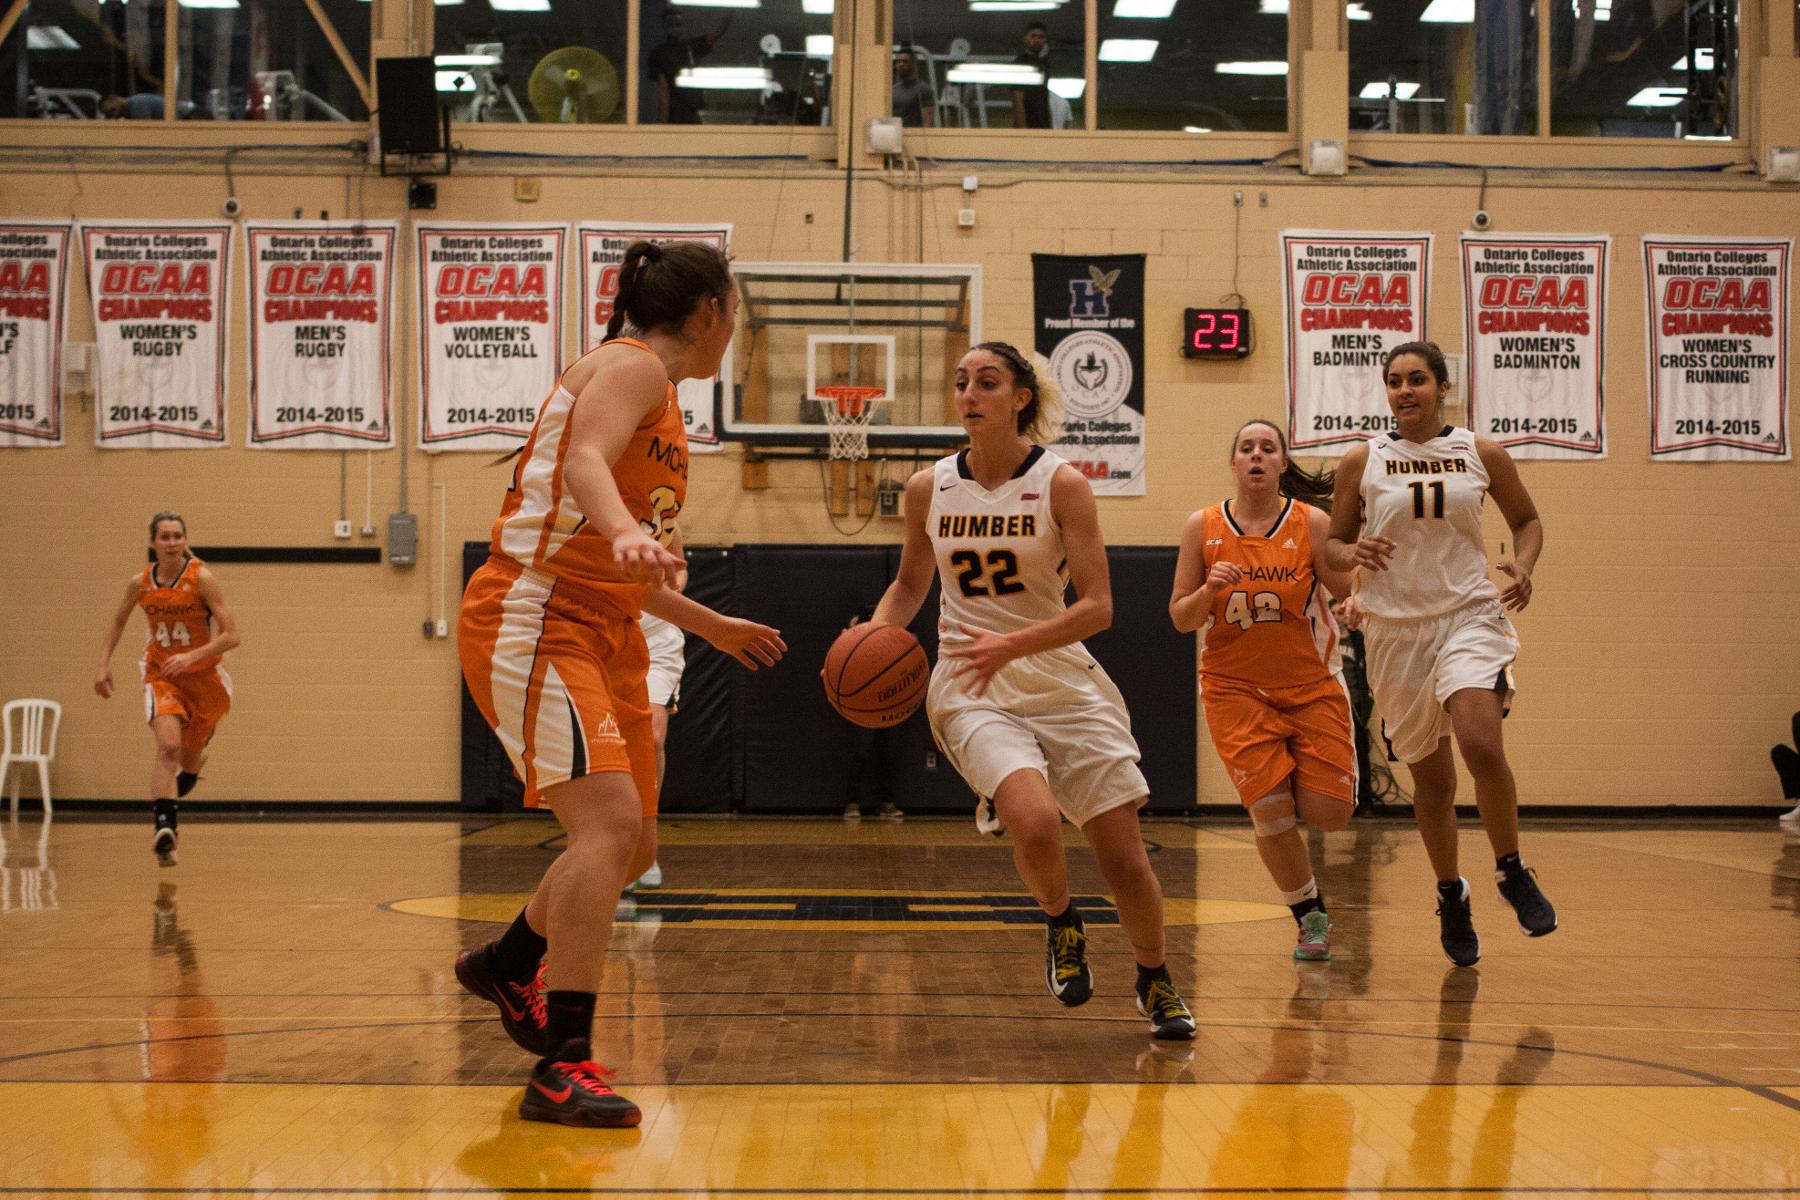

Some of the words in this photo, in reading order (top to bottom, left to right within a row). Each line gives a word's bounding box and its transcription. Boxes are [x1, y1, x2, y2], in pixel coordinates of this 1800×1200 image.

[0, 235, 47, 247] olleges
[105, 236, 150, 247] Ontario
[153, 236, 207, 249] Colleges
[270, 236, 316, 248] Ontario
[319, 236, 373, 249] Colleges
[441, 237, 486, 249] Ontario
[489, 237, 543, 250] Colleges
[95, 248, 142, 260] Athletic
[147, 248, 217, 260] Association
[260, 249, 308, 261] Athletic
[311, 249, 383, 261] Association
[431, 251, 479, 262] Athletic
[481, 251, 553, 262] Association
[592, 252, 624, 263] Athle
[1306, 246, 1351, 258] Ontario
[1354, 246, 1407, 259] Colleges
[1484, 248, 1529, 260] Ontario
[1531, 248, 1584, 262] Colleges
[1667, 251, 1711, 262] Ontario
[1714, 251, 1767, 263] Colleges
[1297, 259, 1344, 271] Athletic
[1346, 259, 1417, 271] Association
[1474, 262, 1521, 274] Athletic
[1523, 262, 1594, 274] Association
[1658, 264, 1703, 276] Athletic
[1706, 264, 1777, 276] Association
[0, 261, 50, 294] AA
[100, 262, 210, 296] OCAA
[265, 263, 376, 296] OCAA
[436, 265, 547, 298] OCAA
[1302, 272, 1413, 307] OCAA
[1479, 275, 1590, 310] OCAA
[1663, 277, 1772, 312] OCAA
[98, 298, 212, 323] CHAMPIONS
[264, 299, 378, 323] CHAMPIONS
[434, 300, 549, 325] CHAMPIONS
[1301, 308, 1413, 333] CHAMPIONS
[1478, 311, 1590, 336] CHAMPIONS
[1662, 313, 1774, 338] CHAMPIONS
[120, 325, 197, 339] WOMEN'S
[295, 326, 347, 340] MEN'S
[453, 327, 530, 341] WOMEN'S
[1193, 313, 1240, 348] 23
[132, 343, 183, 357] RUGBY
[1332, 335, 1382, 350] MEN'S
[1500, 337, 1576, 352] WOMEN'S
[1682, 339, 1752, 353] WOMEN'S
[295, 343, 346, 358] RUGBY
[445, 344, 538, 358] VOLLEYBALL
[1493, 354, 1580, 369] BADMINTON
[1660, 355, 1707, 368] CROSS
[1711, 355, 1776, 368] COUNTRY
[1686, 370, 1750, 384] RUNNING
[110, 406, 198, 421] 2014-2015
[276, 407, 365, 422] 2014-2015
[447, 408, 536, 423] 2014-2015
[1088, 422, 1132, 433] Colleges
[1313, 416, 1399, 431] 2014-2015
[1491, 418, 1577, 434] 2014-2015
[1675, 420, 1761, 435] 2014-2015
[1081, 435, 1140, 445] Association
[1385, 458, 1467, 475] HUMBER
[1407, 480, 1446, 520] 11
[938, 514, 1036, 538] HUMBER
[949, 546, 1027, 597] 22
[1243, 564, 1300, 583] HAWK
[1224, 590, 1283, 631] 42
[155, 620, 192, 648] 44
